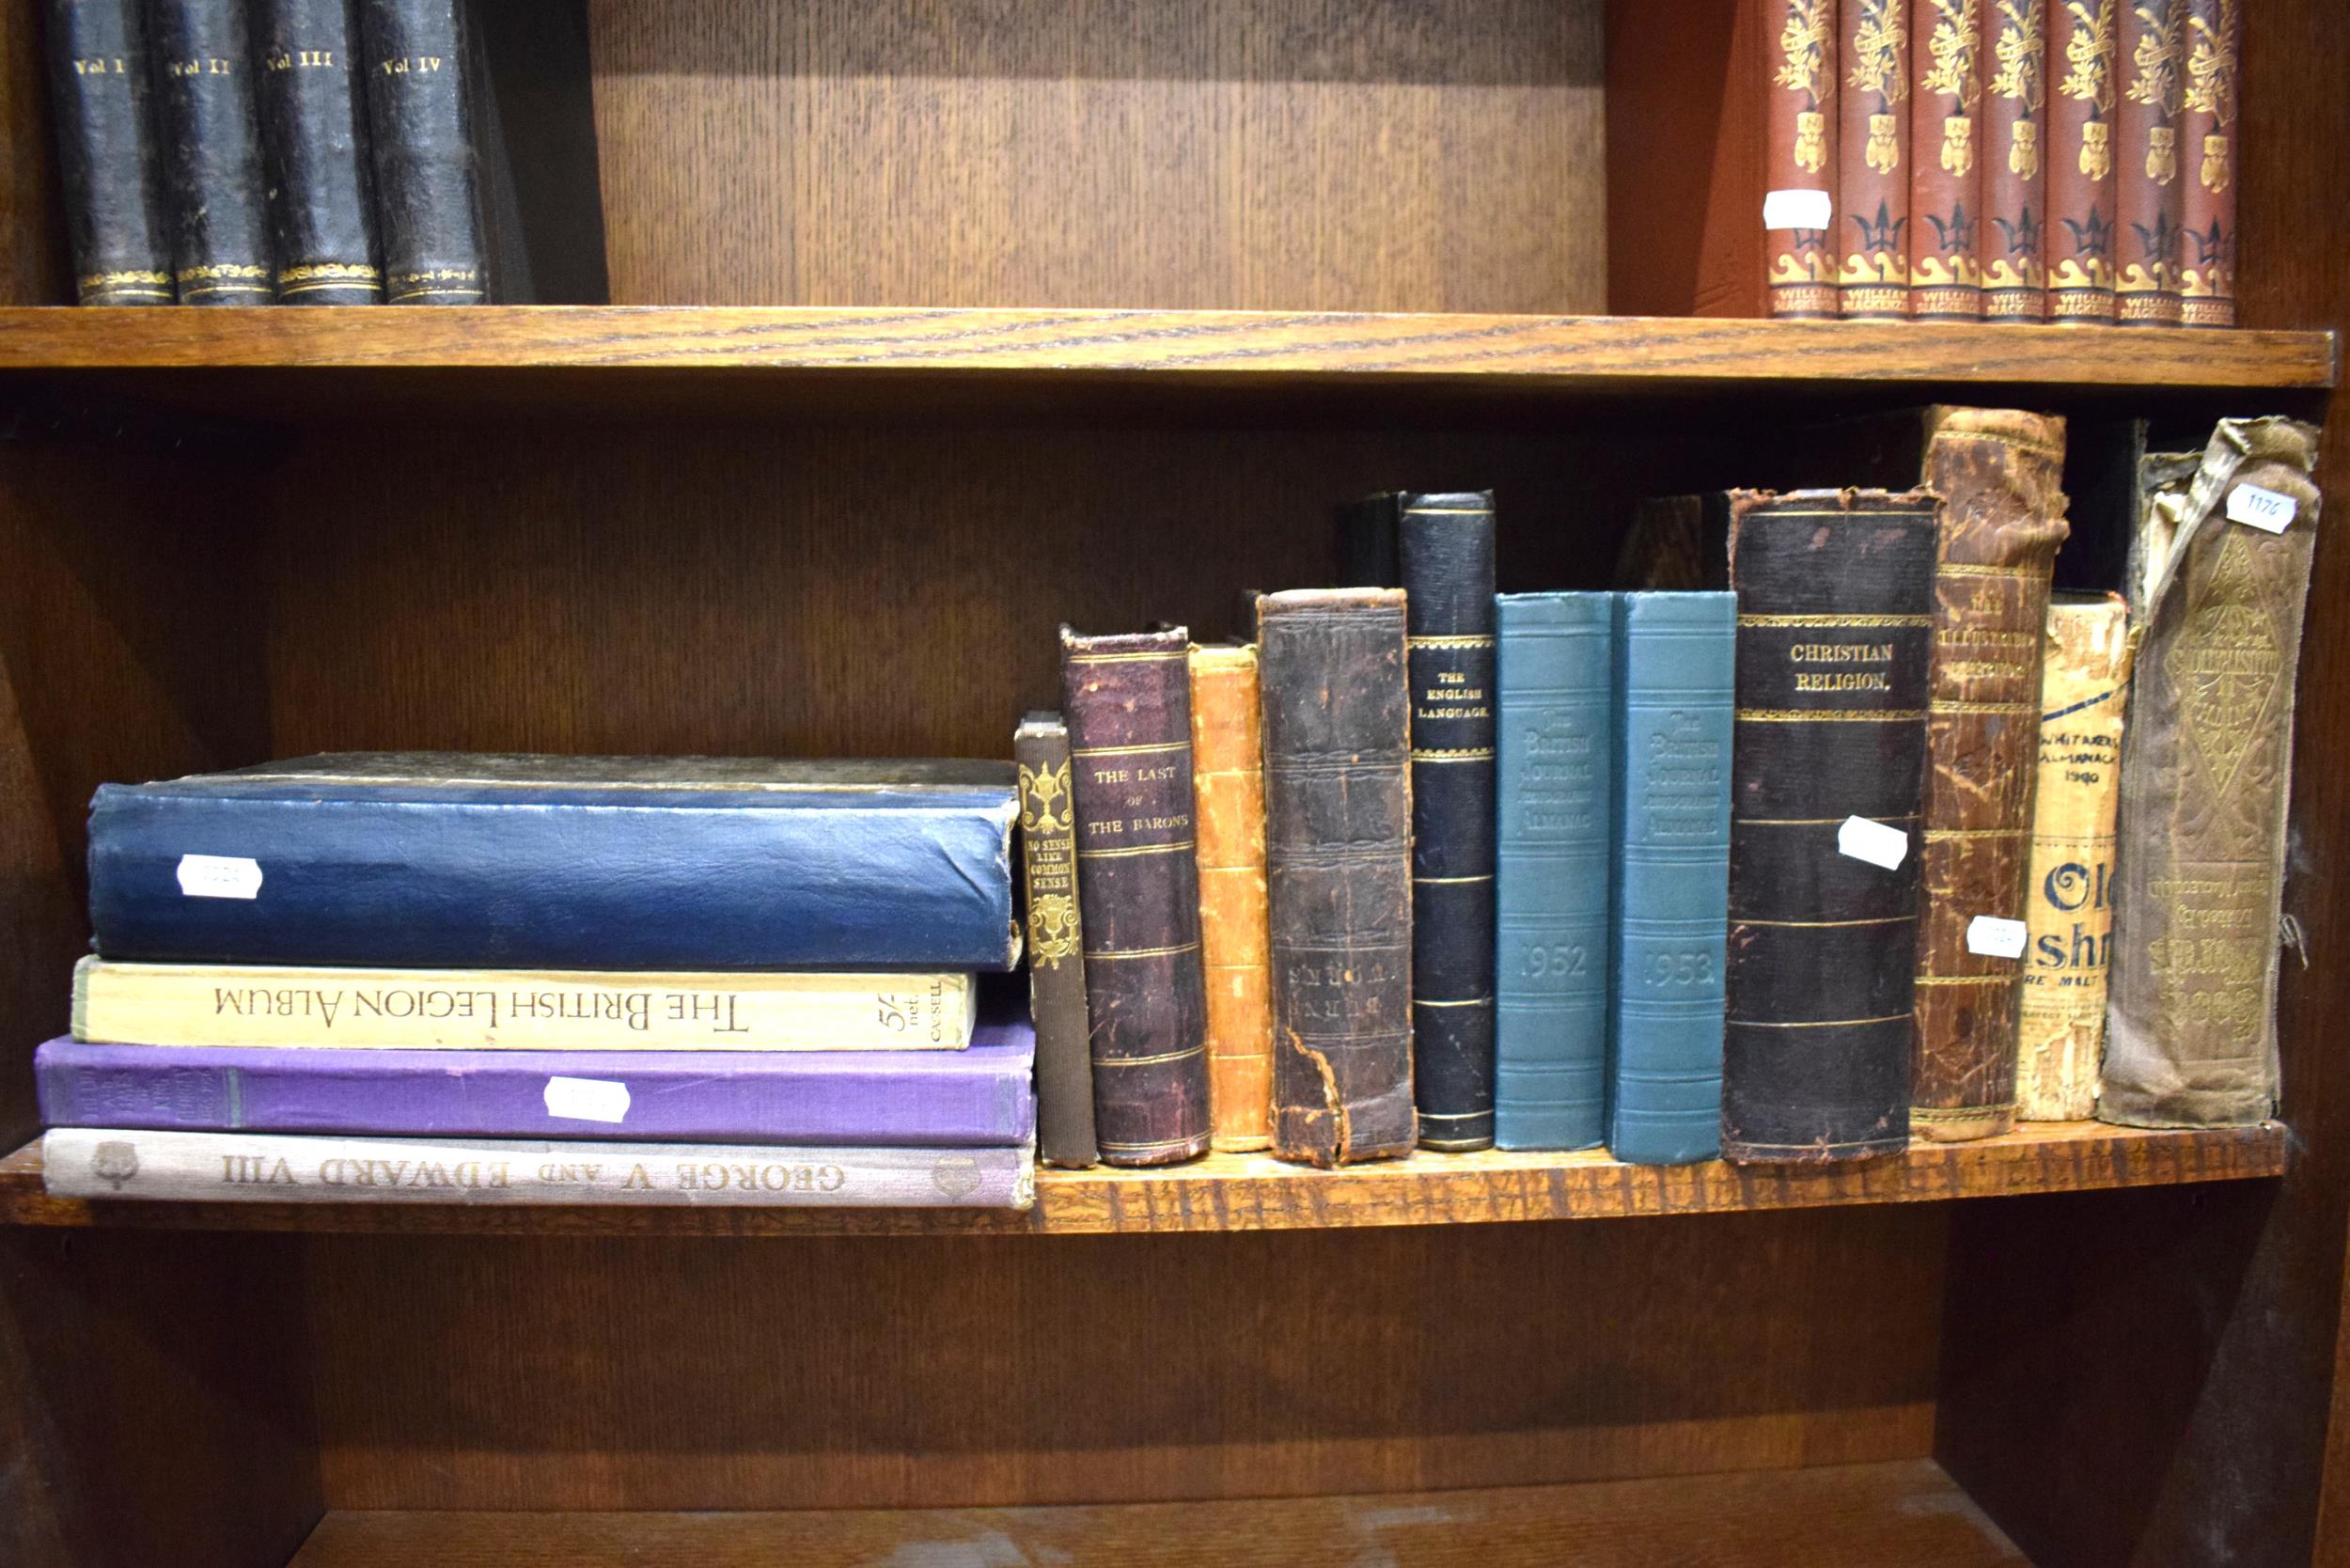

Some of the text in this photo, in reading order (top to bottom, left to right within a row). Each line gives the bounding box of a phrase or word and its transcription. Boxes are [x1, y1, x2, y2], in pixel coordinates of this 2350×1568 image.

[74, 58, 126, 75] Vol I
[173, 58, 230, 75] Vol II
[267, 50, 334, 71] Vol III
[383, 56, 443, 74] Vol IV
[2248, 494, 2281, 516] 1176
[1790, 643, 1894, 663] CHRISTIAN
[1437, 671, 1465, 683] THE
[1794, 671, 1891, 691] RELIGION.
[1427, 688, 1482, 700] ENGLISH
[1093, 766, 1176, 784] THE LAST
[1089, 813, 1189, 835] THE BARONS
[1042, 839, 1073, 850] SENSE
[1037, 852, 1062, 862] LIKE
[1031, 863, 1071, 874] COMMON
[1034, 877, 1070, 888] SENSE
[1521, 943, 1588, 979] 1952
[214, 987, 749, 1032] THE BRITISH LEGION ALBUM
[903, 994, 918, 1026] net.
[931, 980, 942, 1043] CASELL
[152, 1076, 172, 1111] KING
[222, 1154, 845, 1192] GEORGE V AND EDWARD VIII
